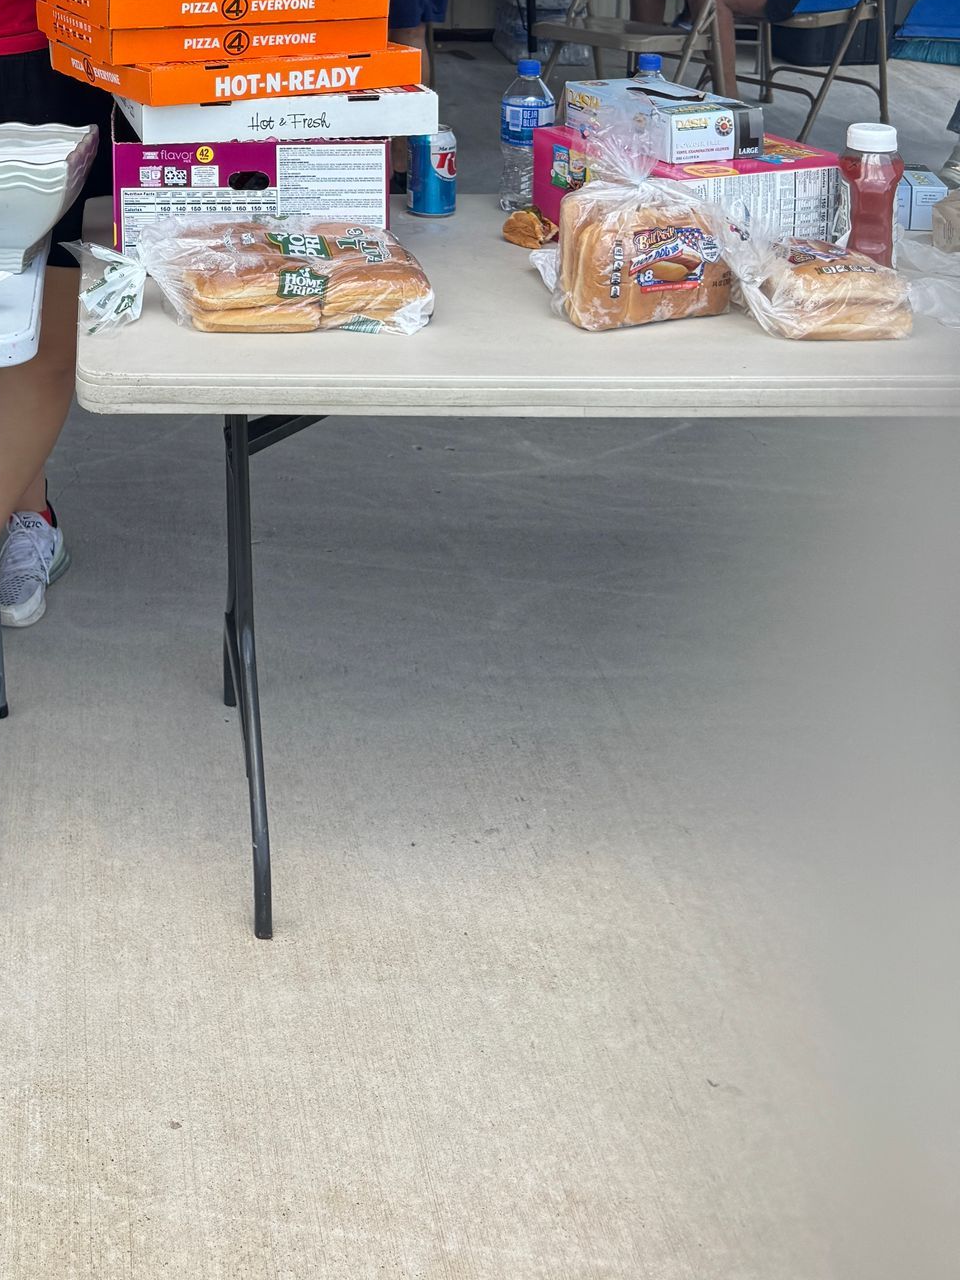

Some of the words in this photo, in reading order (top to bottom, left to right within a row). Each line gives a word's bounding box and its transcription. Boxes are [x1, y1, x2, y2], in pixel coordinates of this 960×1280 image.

[181, 1, 218, 15] PIZZA
[184, 36, 220, 50] PIZZA
[225, 31, 248, 54] 4
[252, 32, 316, 47] EVERYONE
[70, 57, 85, 72] PIZZA
[93, 67, 121, 86] EVERYONE
[215, 66, 361, 98] HOT-N-READY
[248, 114, 275, 130] Hot
[290, 112, 331, 129] Fresh
[160, 150, 194, 160] flavor
[199, 149, 210, 158] 42
[738, 146, 759, 155] LARGE
[289, 233, 305, 257] HO
[304, 235, 326, 258] PRI
[285, 271, 324, 288] HOME
[644, 269, 654, 281] 8
[283, 284, 323, 297] PRIDE
